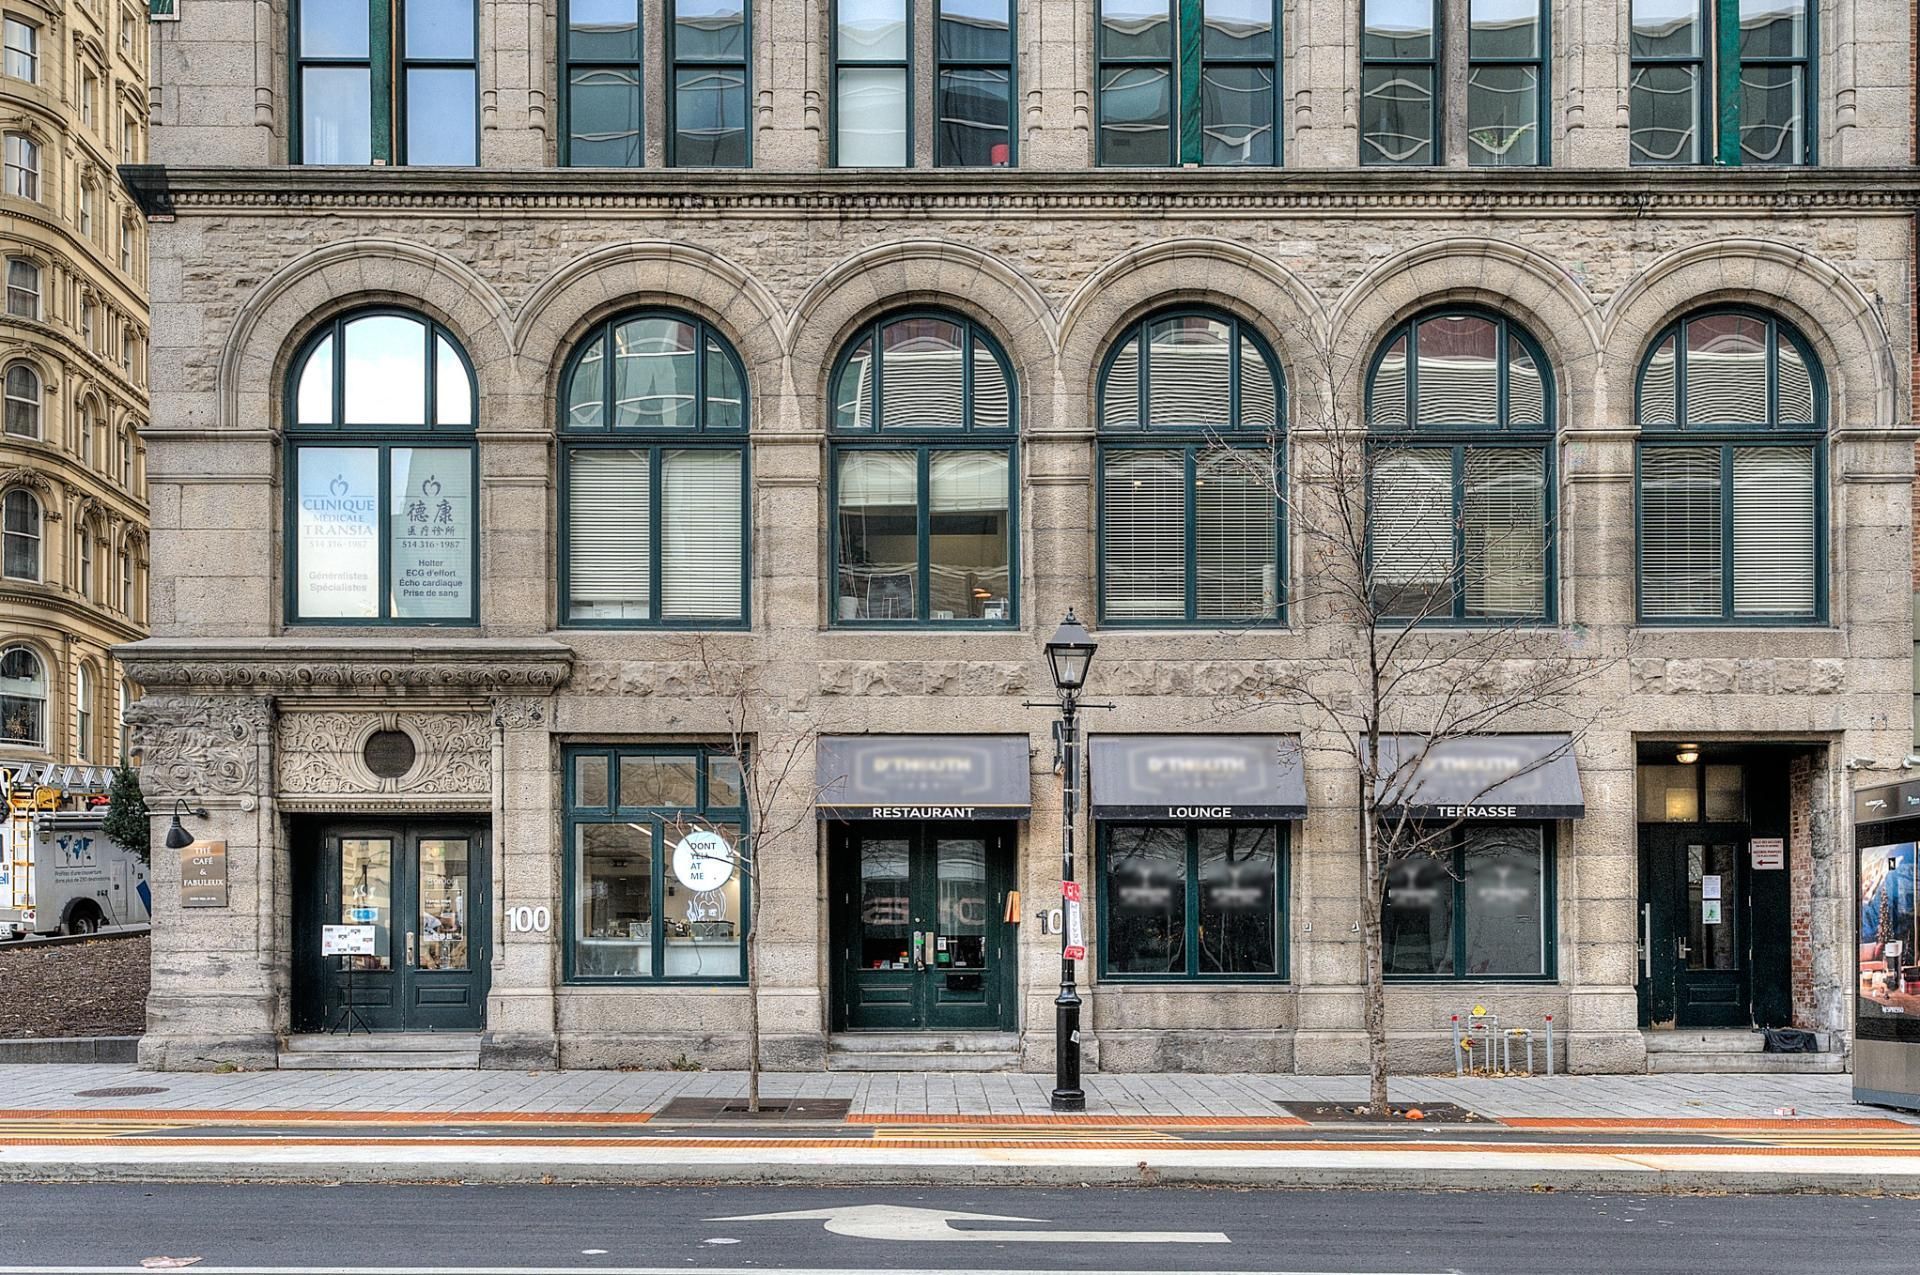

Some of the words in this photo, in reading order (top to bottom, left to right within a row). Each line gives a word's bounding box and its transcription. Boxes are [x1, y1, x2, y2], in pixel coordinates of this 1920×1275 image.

[303, 499, 375, 513] CLINIQUE
[407, 499, 454, 524] 德康
[313, 512, 364, 523] MÉDICALE
[304, 525, 374, 536] TRANSIA
[418, 559, 444, 567] Holter
[406, 569, 425, 577] ECG
[399, 577, 420, 587] Écho
[422, 579, 463, 588] cardiaque
[403, 589, 424, 597] Prise
[426, 589, 437, 597] de
[438, 590, 459, 598] sang
[872, 807, 975, 818] RESTAURANT
[1168, 807, 1232, 818] LOUNGE
[1437, 806, 1517, 817] TERRASSE
[690, 842, 717, 850] DONT
[192, 856, 214, 865] CAFÉ
[690, 862, 702, 870] AT
[199, 868, 208, 876] &
[690, 872, 704, 880] ME
[183, 879, 224, 887] FABULEUX
[505, 906, 550, 932] 100
